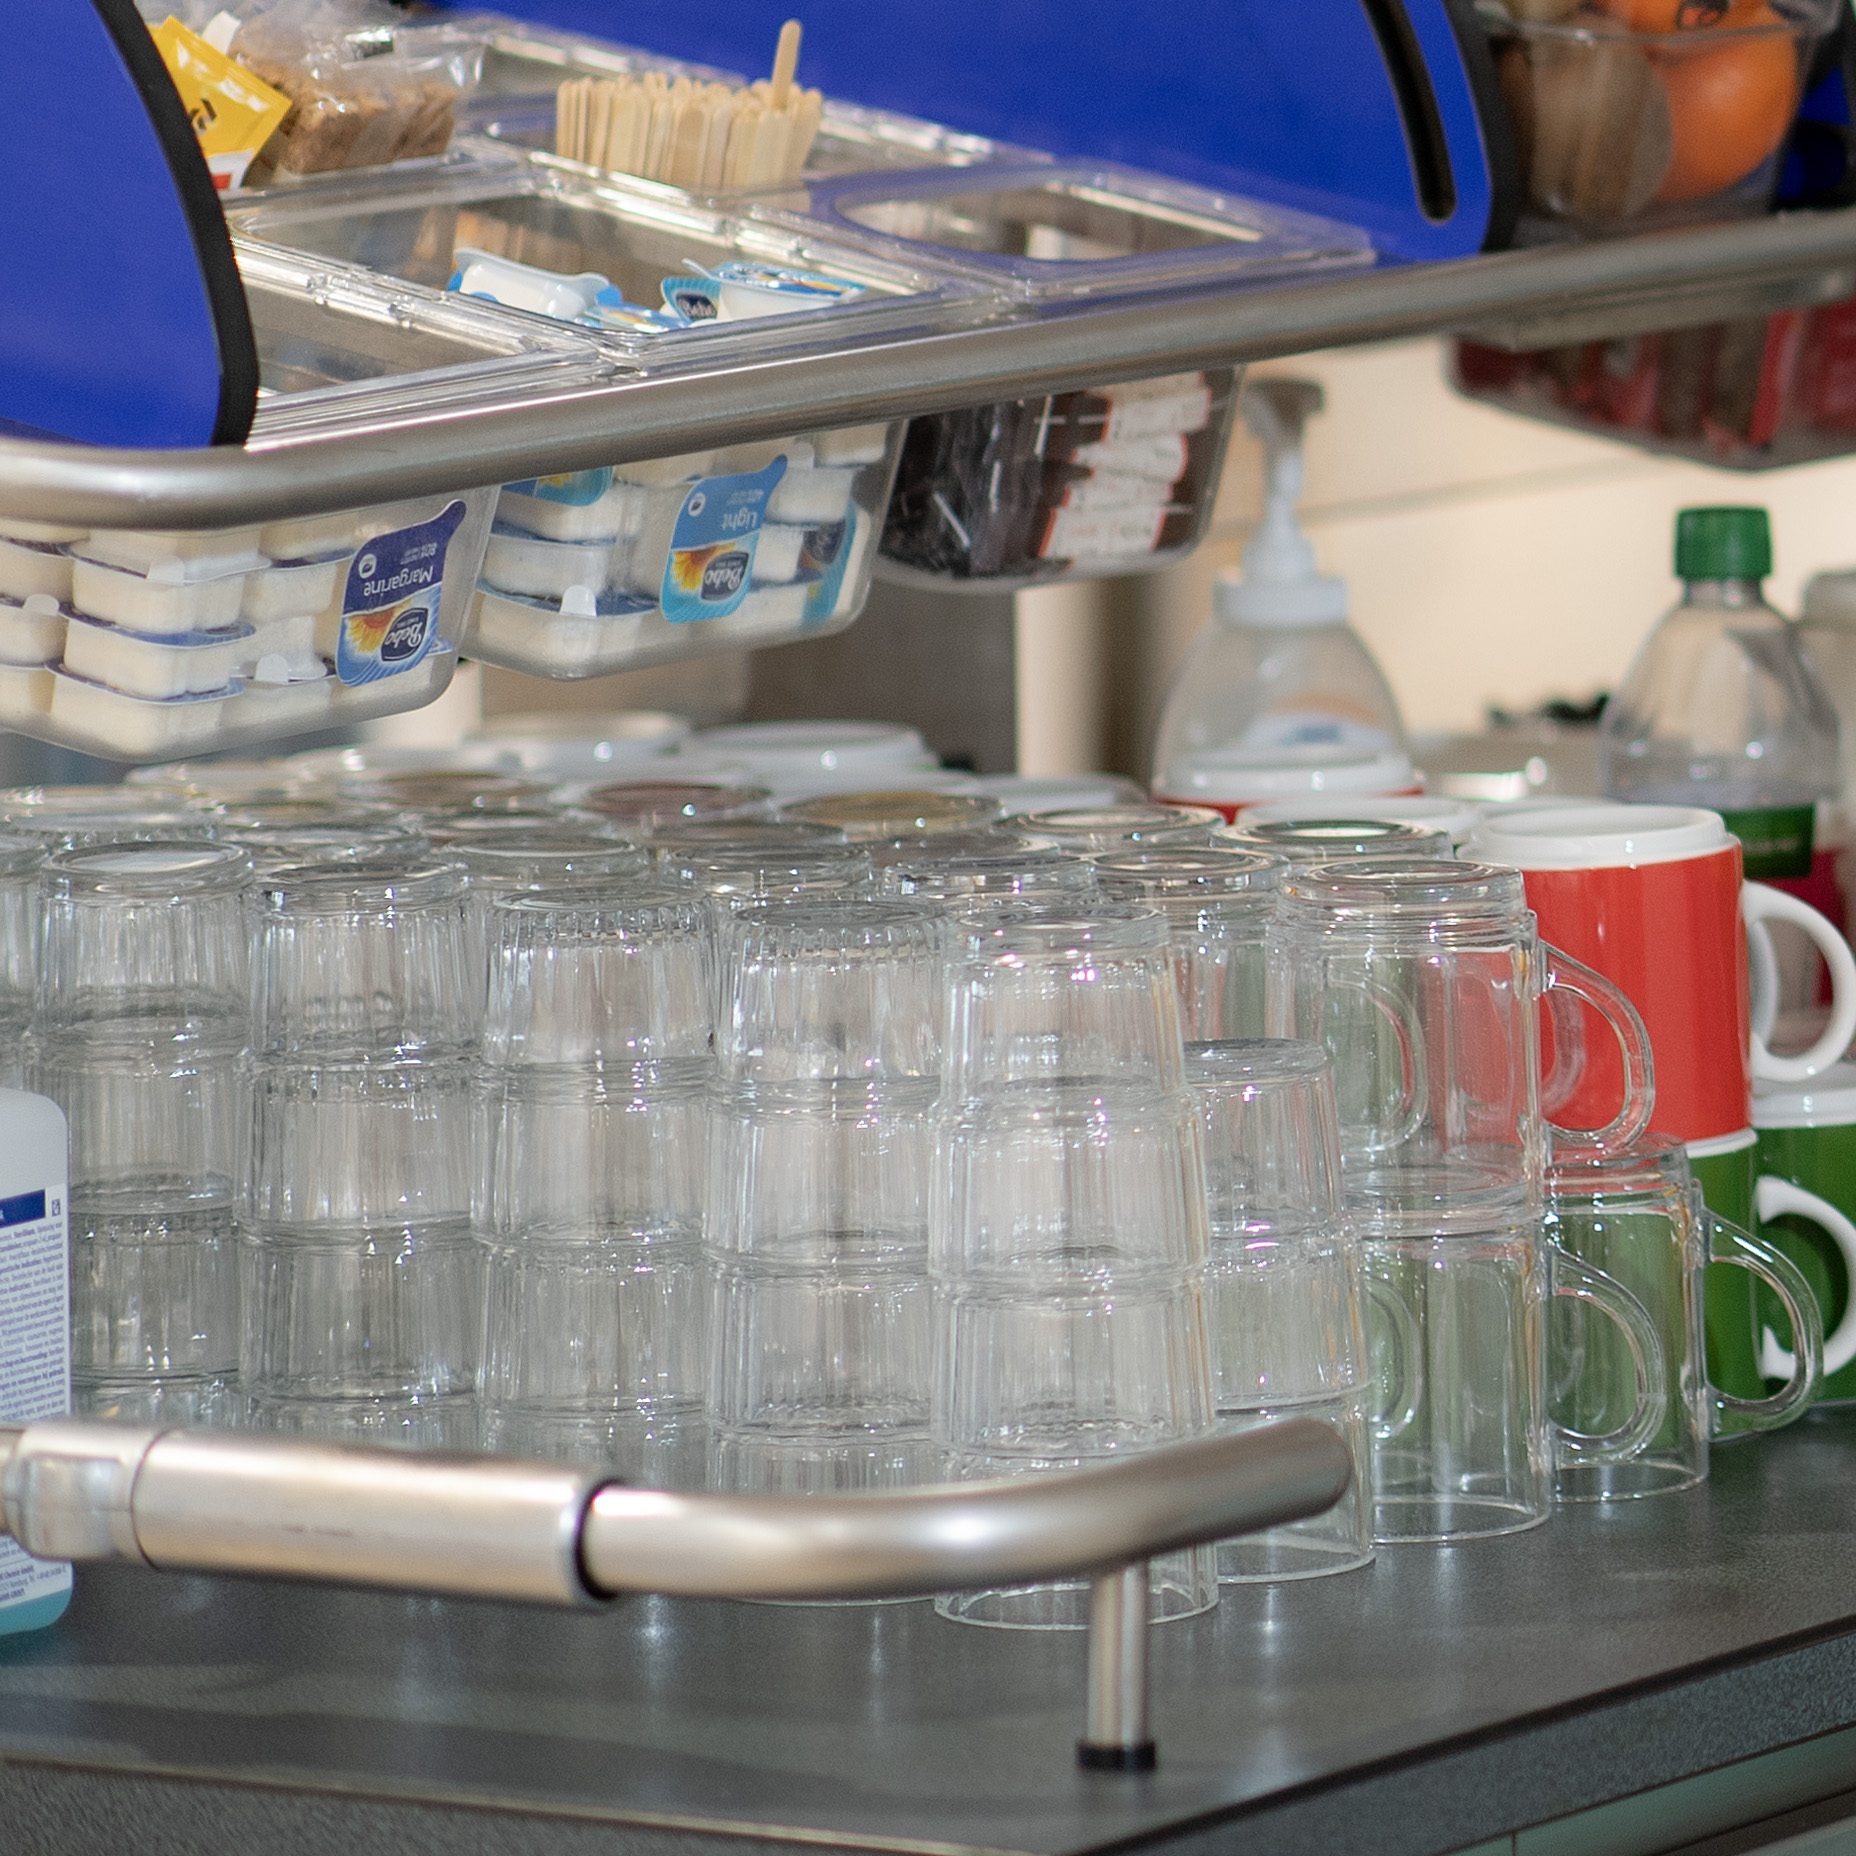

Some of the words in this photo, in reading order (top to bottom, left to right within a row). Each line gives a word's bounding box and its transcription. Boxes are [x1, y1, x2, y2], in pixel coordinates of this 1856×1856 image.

[721, 507, 758, 532] Light
[363, 565, 434, 597] Margarine
[704, 566, 744, 591] Bebo
[385, 620, 423, 649] Bebo
